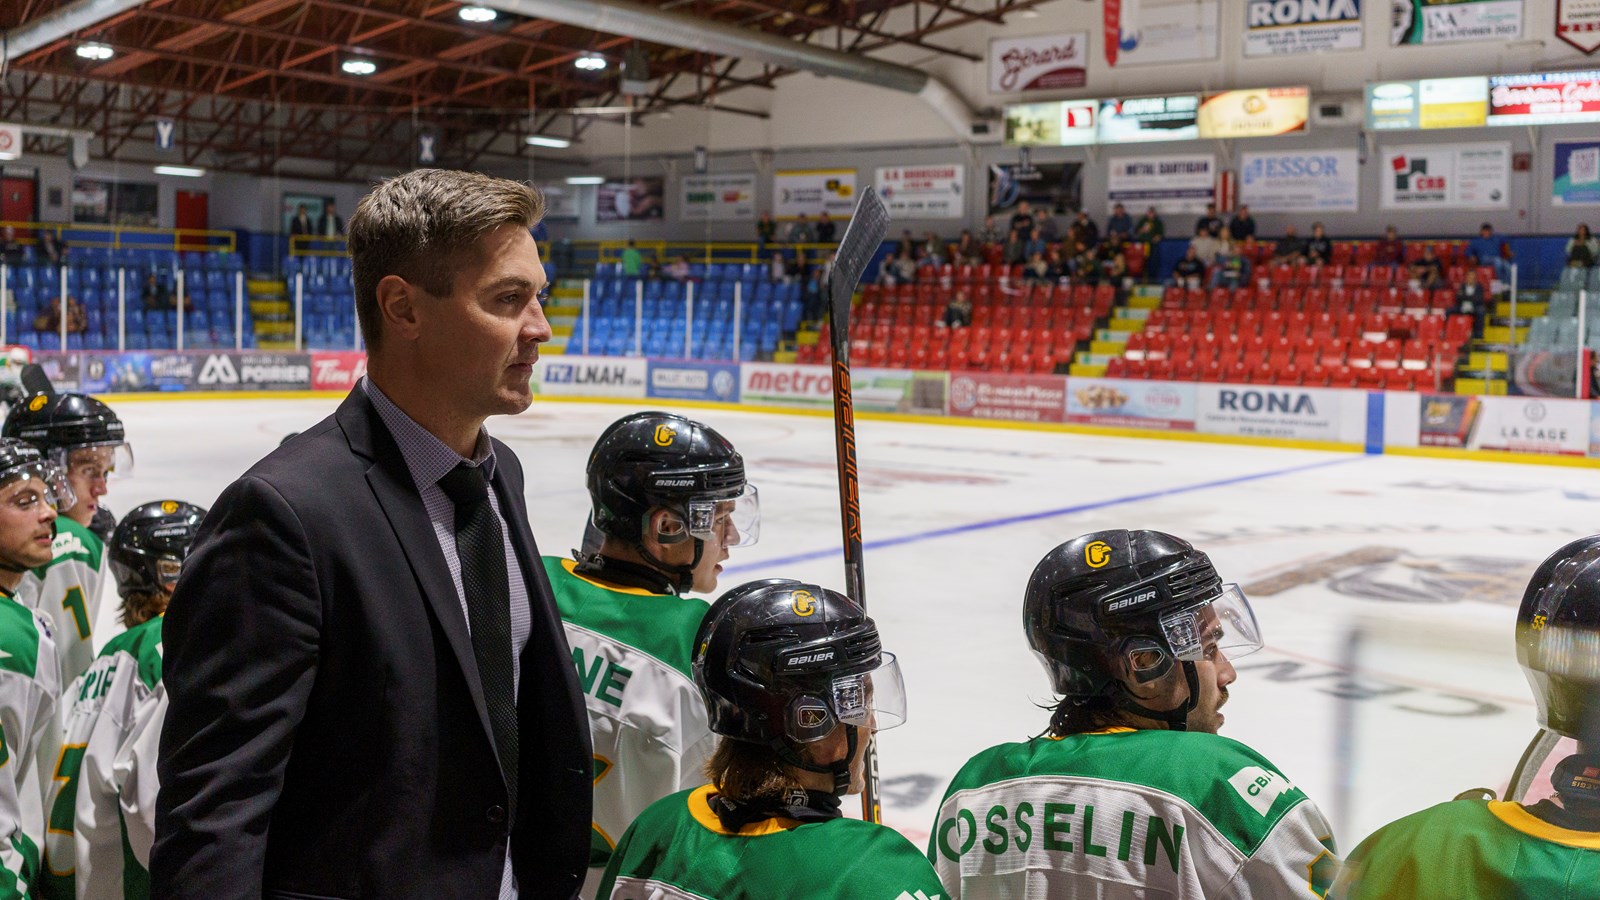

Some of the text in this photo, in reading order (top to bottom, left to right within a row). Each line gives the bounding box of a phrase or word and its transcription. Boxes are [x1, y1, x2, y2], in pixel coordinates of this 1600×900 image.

[1248, 0, 1359, 26] RONA
[157, 120, 174, 149] Y
[1265, 156, 1338, 177] ESSOR
[241, 365, 310, 383] POIRIER
[316, 361, 350, 385] Tim
[749, 369, 832, 394] metro
[1219, 390, 1316, 414] RONA
[1500, 427, 1519, 438] LA
[655, 479, 696, 488] BAUER
[1108, 590, 1156, 612] BAUER
[1532, 614, 1547, 631] 55
[787, 651, 835, 667] BAUER
